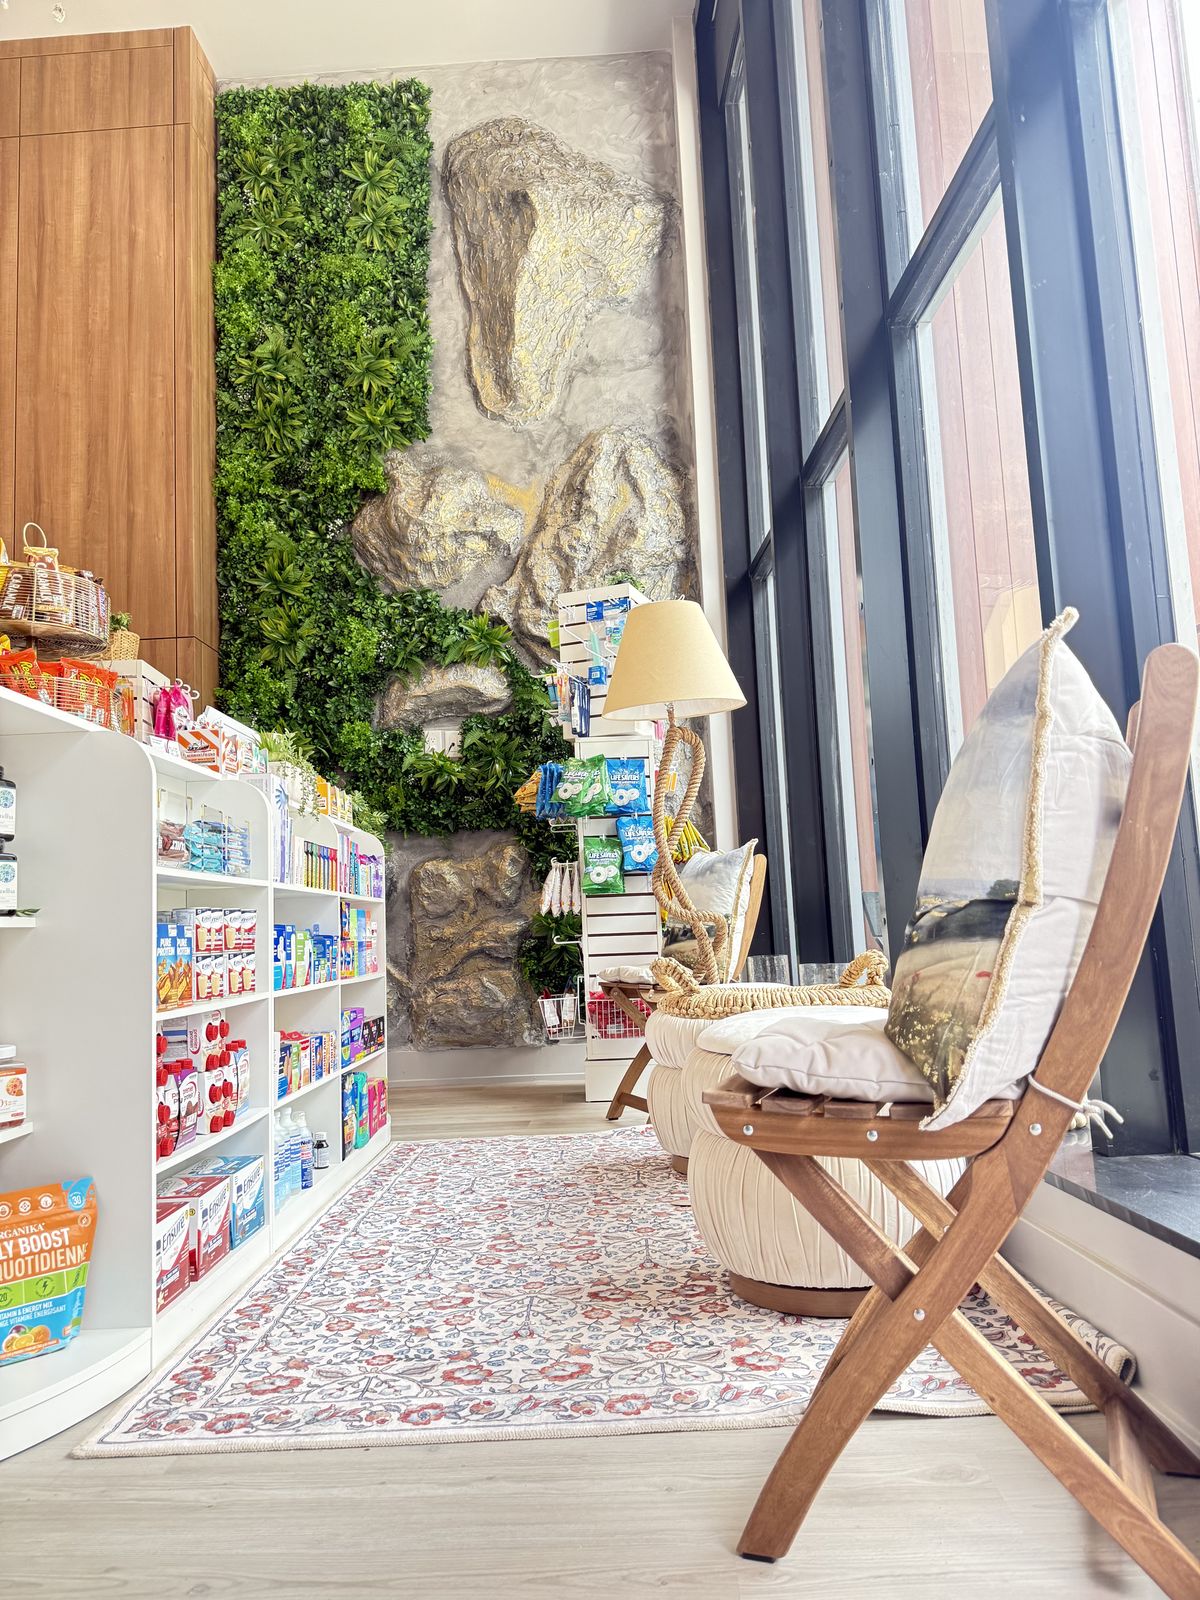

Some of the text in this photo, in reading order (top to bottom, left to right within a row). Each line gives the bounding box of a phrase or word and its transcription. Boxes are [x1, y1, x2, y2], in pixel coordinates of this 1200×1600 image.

[244, 1166, 261, 1194] Ensure
[209, 1187, 227, 1219] Ensure
[18, 1227, 70, 1256] BOOST
[162, 1215, 185, 1252] Ensure
